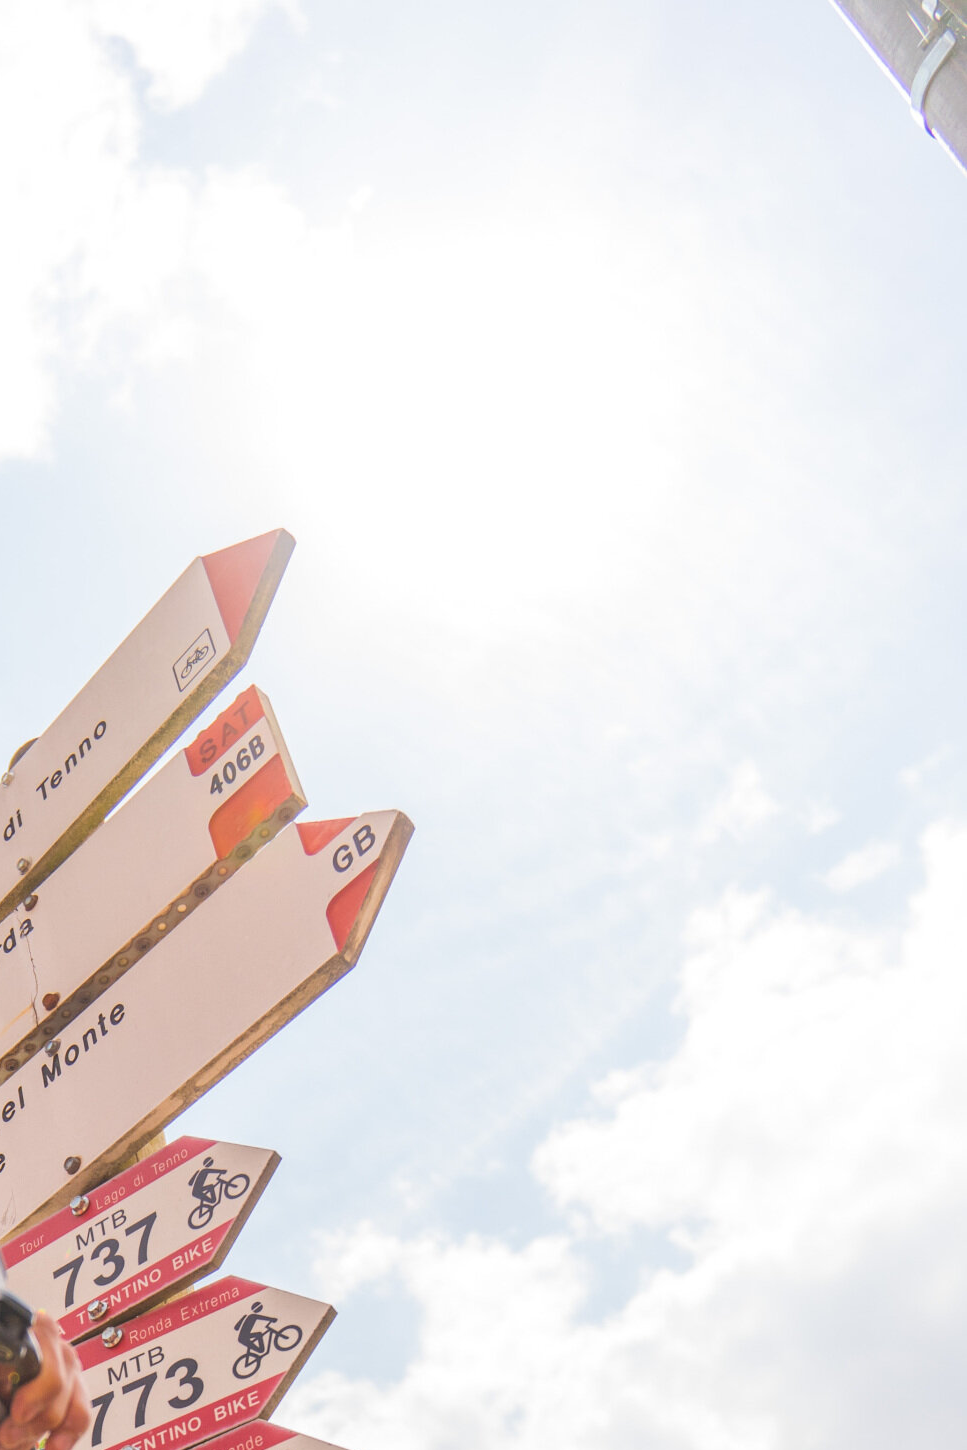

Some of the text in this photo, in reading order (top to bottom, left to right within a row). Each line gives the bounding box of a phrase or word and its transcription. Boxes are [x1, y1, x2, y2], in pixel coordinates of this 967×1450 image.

[199, 700, 252, 765] SAT
[3, 809, 23, 842] di
[36, 719, 108, 802] Tenno
[208, 734, 266, 797] 406B
[332, 824, 378, 875] GB
[41, 1003, 126, 1088] Monte
[19, 1148, 190, 1256] Tour Lago di Tenno
[75, 1208, 128, 1251] MTB
[52, 1211, 158, 1311] 737
[76, 1237, 215, 1326] TNTINO BIKE
[129, 1285, 241, 1345] Ronda Extrema
[107, 1346, 166, 1386] MTB
[91, 1357, 205, 1448] 773
[213, 1390, 261, 1423] BIKE
